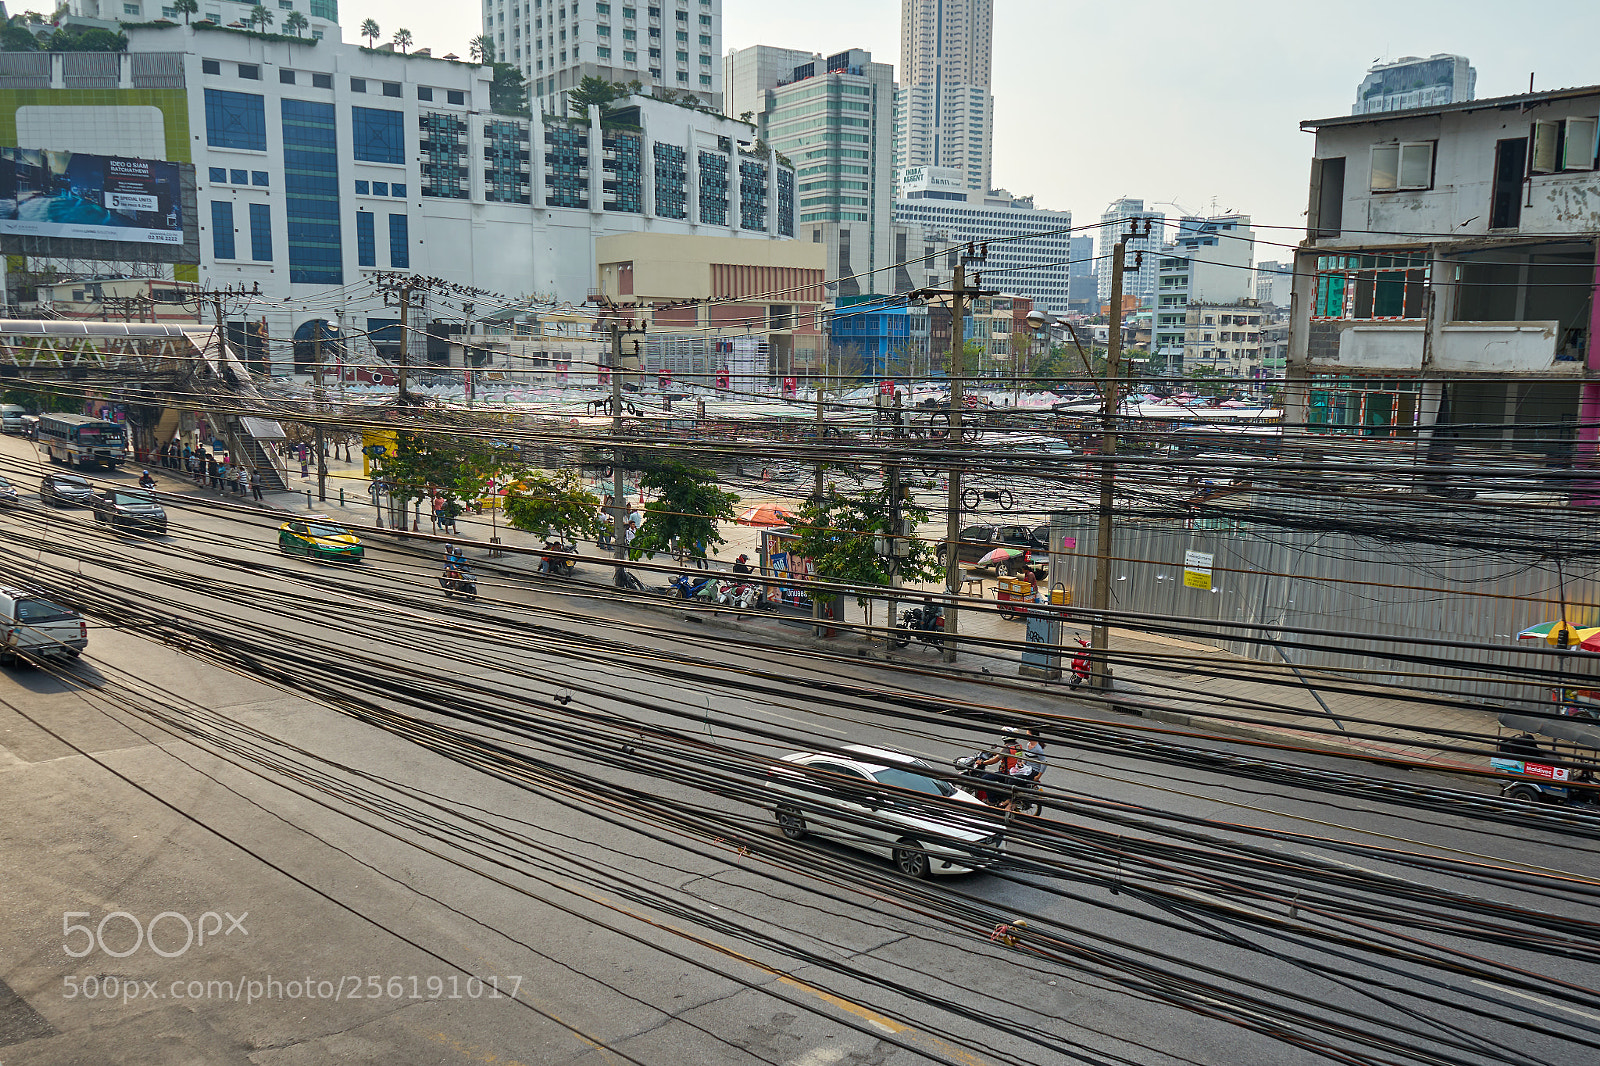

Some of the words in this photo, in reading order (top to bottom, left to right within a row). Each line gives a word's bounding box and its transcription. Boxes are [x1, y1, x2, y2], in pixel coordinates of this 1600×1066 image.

[110, 166, 149, 174] RATCHATHEWI
[905, 168, 921, 176] INDRA
[904, 174, 924, 183] REGENT
[112, 195, 120, 207] 5
[1526, 766, 1552, 775] Maldives
